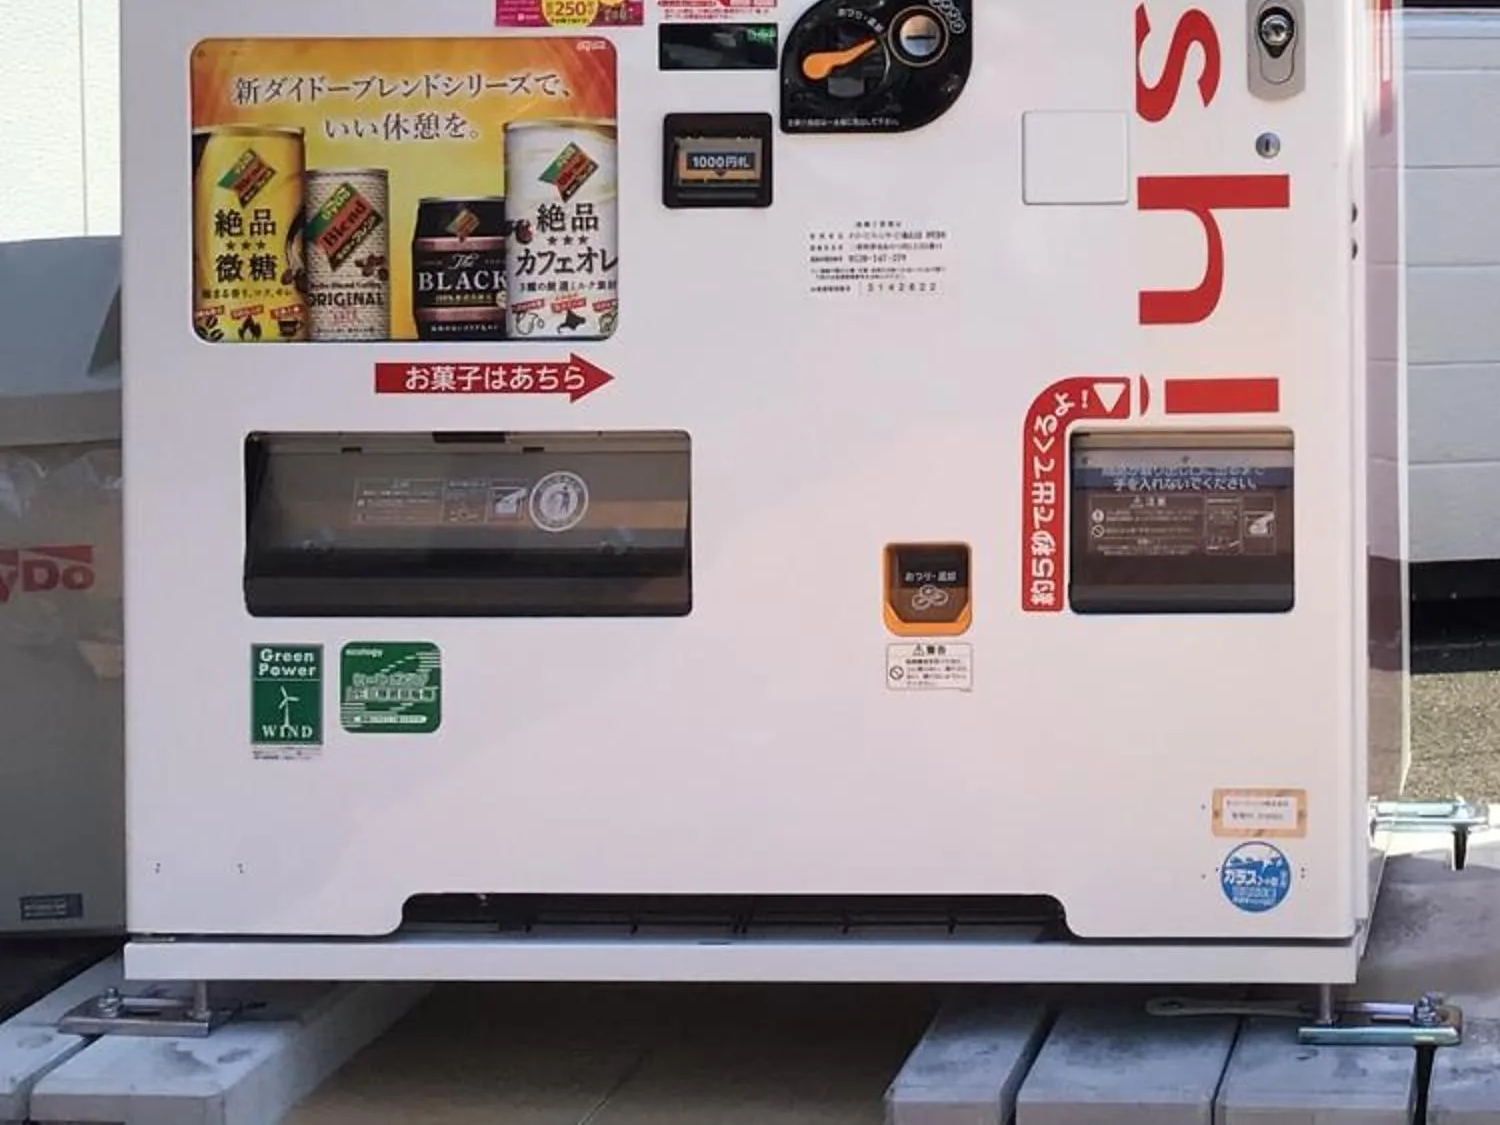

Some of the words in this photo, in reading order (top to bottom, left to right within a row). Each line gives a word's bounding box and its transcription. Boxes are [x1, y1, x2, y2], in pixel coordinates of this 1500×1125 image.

[235, 74, 572, 104] 新ダイドーブレンドシリーズで、
[325, 112, 480, 141] いい休憩を。
[693, 154, 750, 169] 1000円札
[214, 208, 277, 238] 絶品
[537, 203, 600, 233] 絶品
[215, 253, 278, 283] 微糖
[515, 246, 619, 276] カフェオレ
[419, 270, 507, 291] BLACK
[405, 364, 586, 391] お菓子はあちら
[260, 648, 315, 663] Green
[258, 663, 317, 677] Power
[262, 725, 313, 739] WIND
